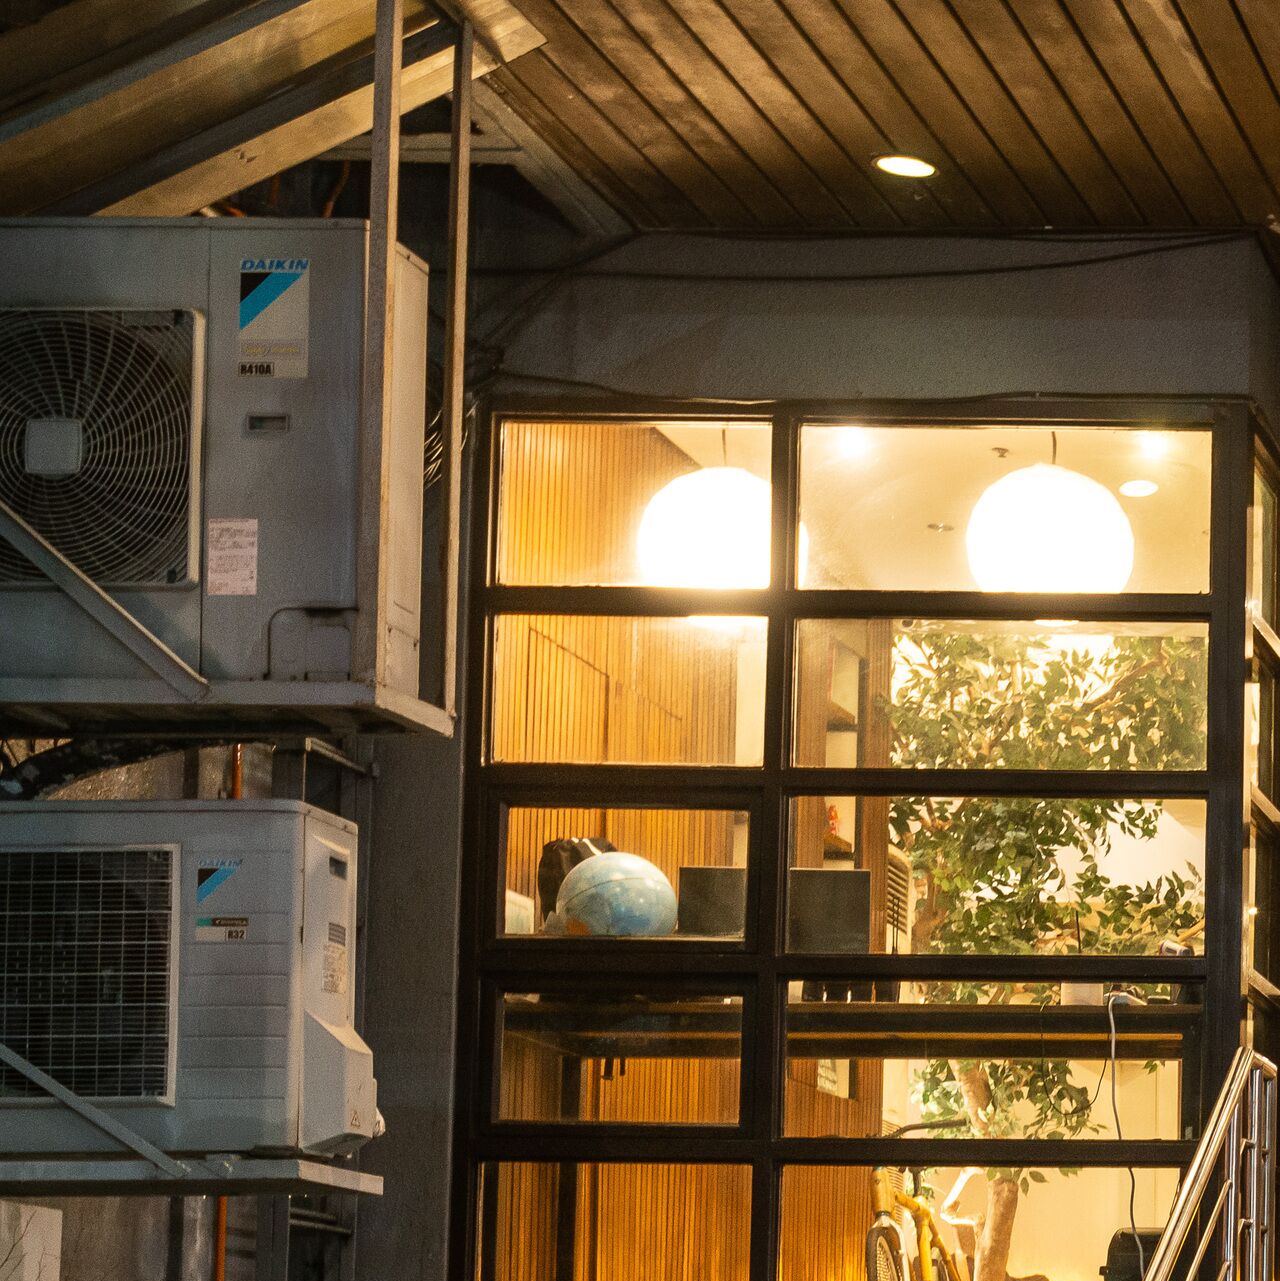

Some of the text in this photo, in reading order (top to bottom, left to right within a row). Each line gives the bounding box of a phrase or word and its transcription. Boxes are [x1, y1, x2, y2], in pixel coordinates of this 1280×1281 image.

[242, 259, 309, 271] DAIKIN
[240, 363, 272, 375] R410A
[228, 930, 245, 939] R32
